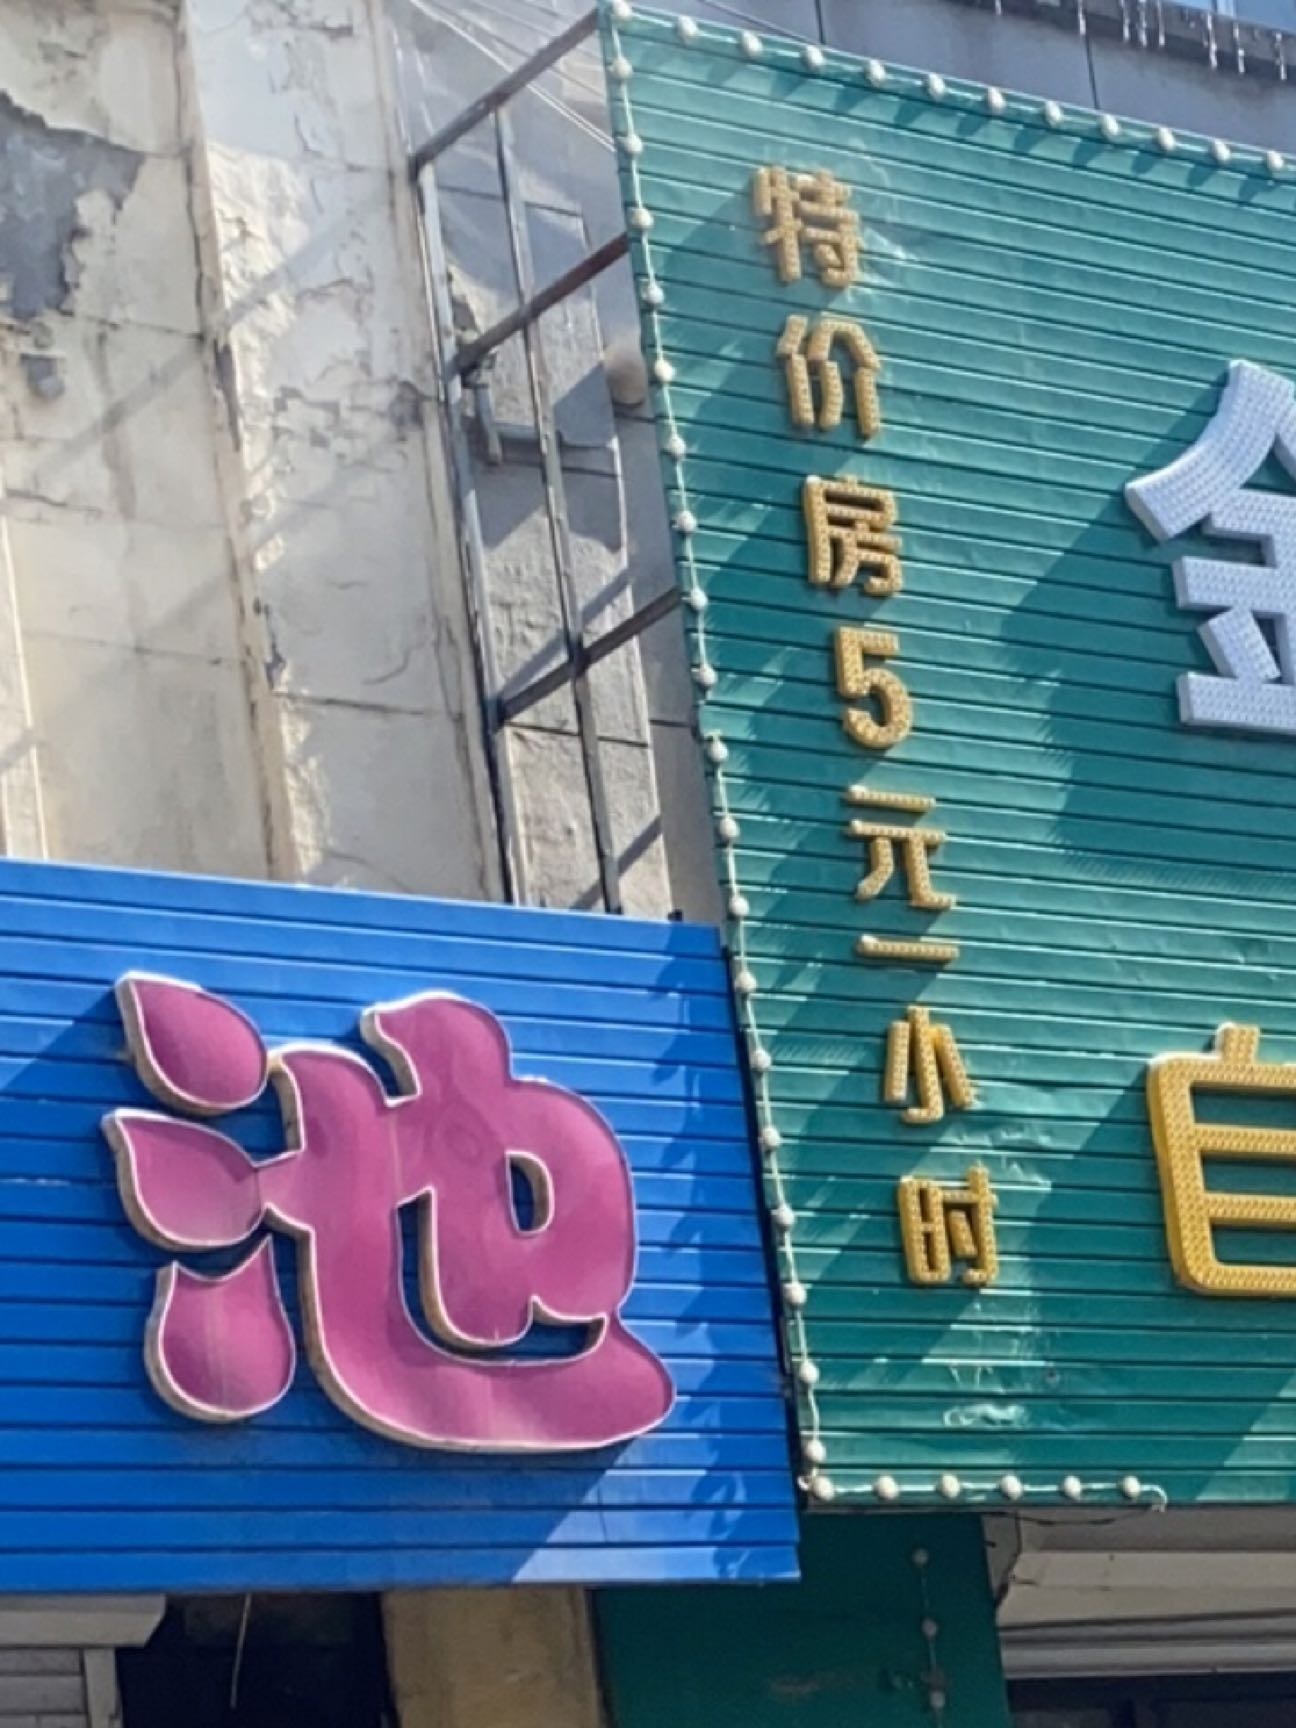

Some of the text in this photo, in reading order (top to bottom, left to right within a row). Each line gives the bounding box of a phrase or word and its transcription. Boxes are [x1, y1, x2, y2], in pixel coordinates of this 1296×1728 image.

[751, 163, 1000, 1288] 特价房5元一小时
[101, 970, 677, 1454] 池
